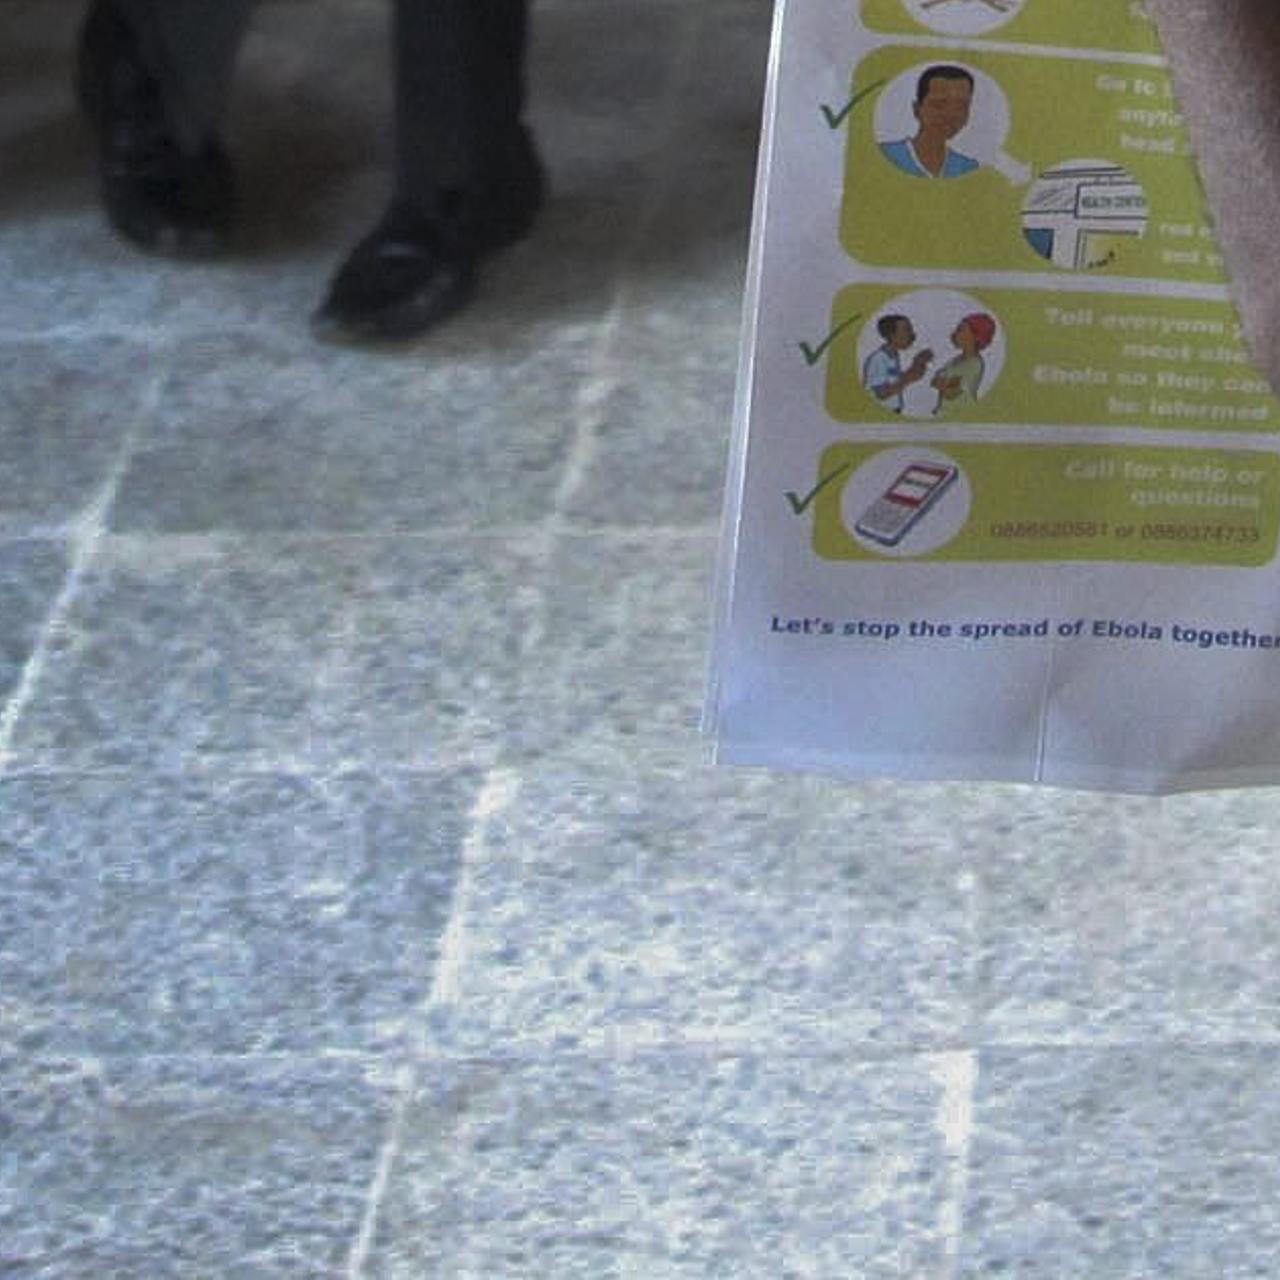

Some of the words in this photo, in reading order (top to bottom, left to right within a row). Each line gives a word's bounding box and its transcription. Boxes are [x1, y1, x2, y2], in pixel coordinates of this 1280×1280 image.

[1045, 307, 1094, 327] Tell
[1033, 363, 1109, 386] Ebola
[1157, 370, 1217, 393] they
[1150, 396, 1270, 423] informed
[1065, 458, 1115, 480] Call
[1124, 460, 1161, 482] for
[1170, 462, 1228, 484] help
[770, 616, 834, 636] Let's
[842, 619, 900, 641] stop
[908, 619, 952, 638] the
[960, 616, 1048, 641] spread
[1056, 619, 1084, 638] of
[1092, 618, 1164, 641] Ebola
